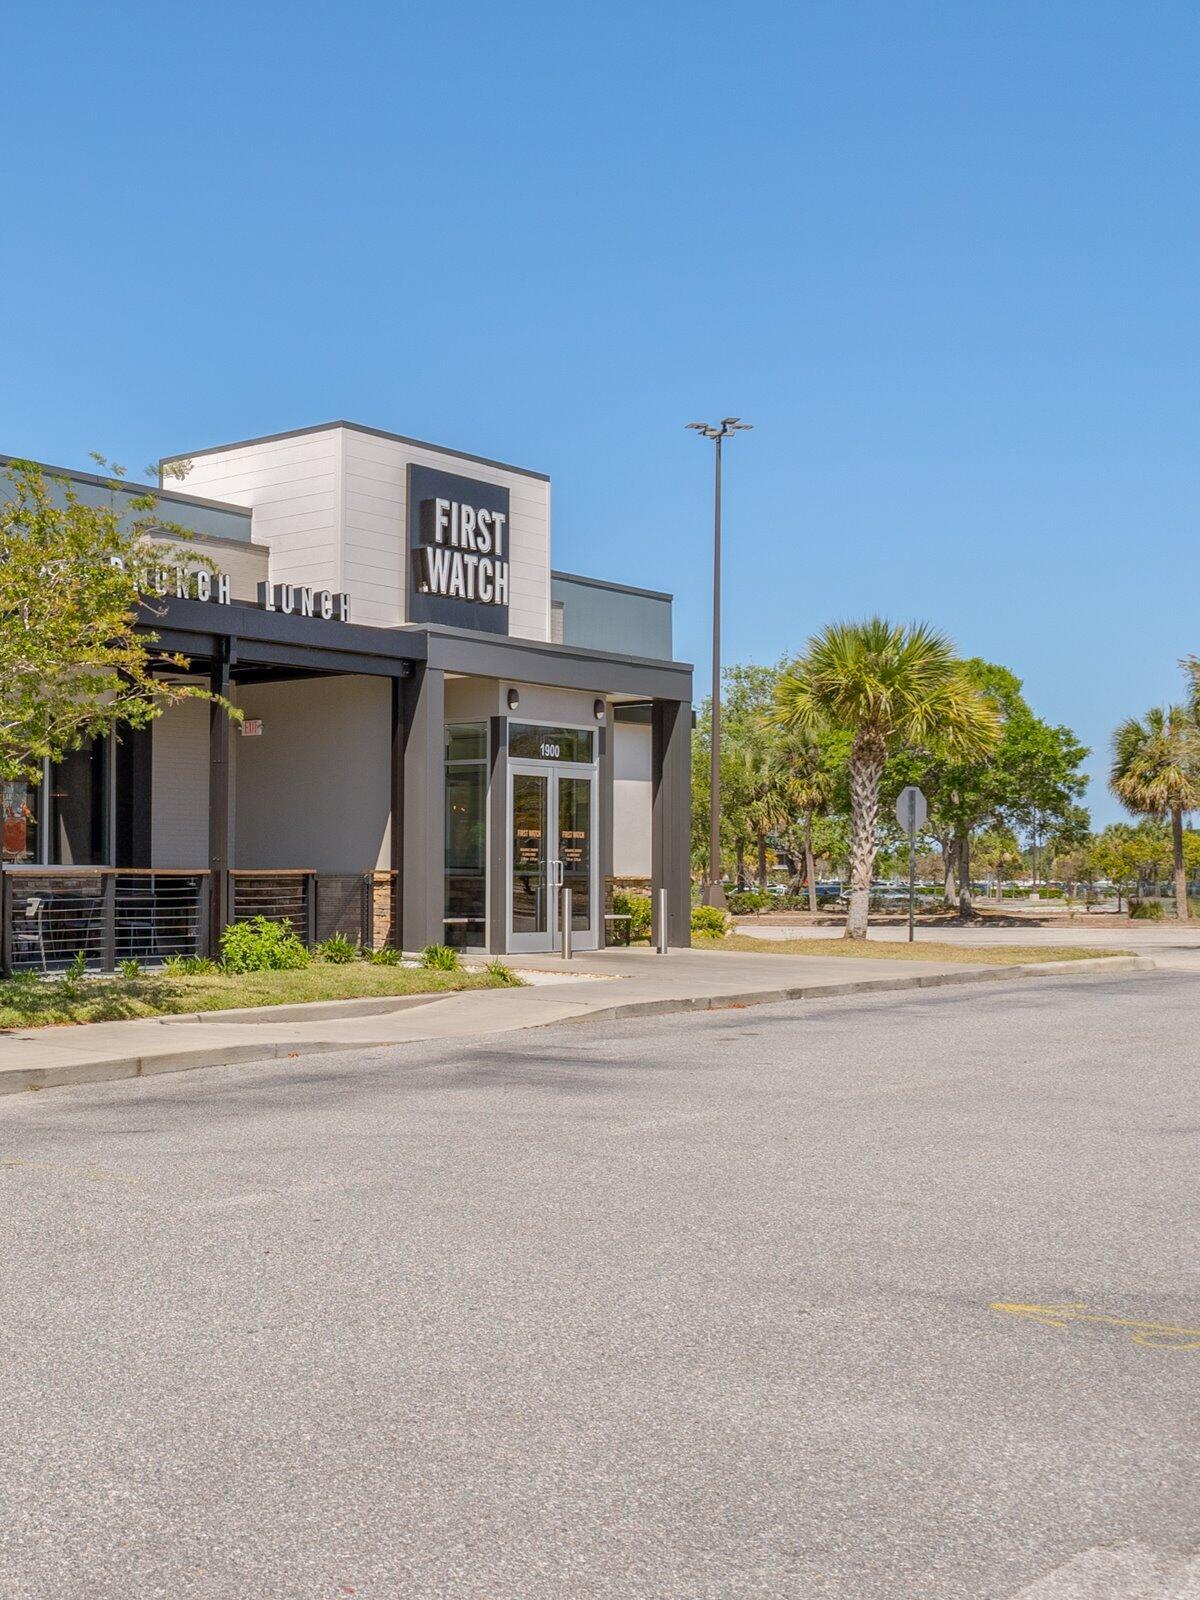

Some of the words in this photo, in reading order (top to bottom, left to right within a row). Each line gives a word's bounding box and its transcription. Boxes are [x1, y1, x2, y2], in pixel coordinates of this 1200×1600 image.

[435, 497, 506, 556] FIRST
[263, 580, 351, 623] LUNCH
[427, 546, 509, 606] WATCH
[540, 743, 560, 758] 1900
